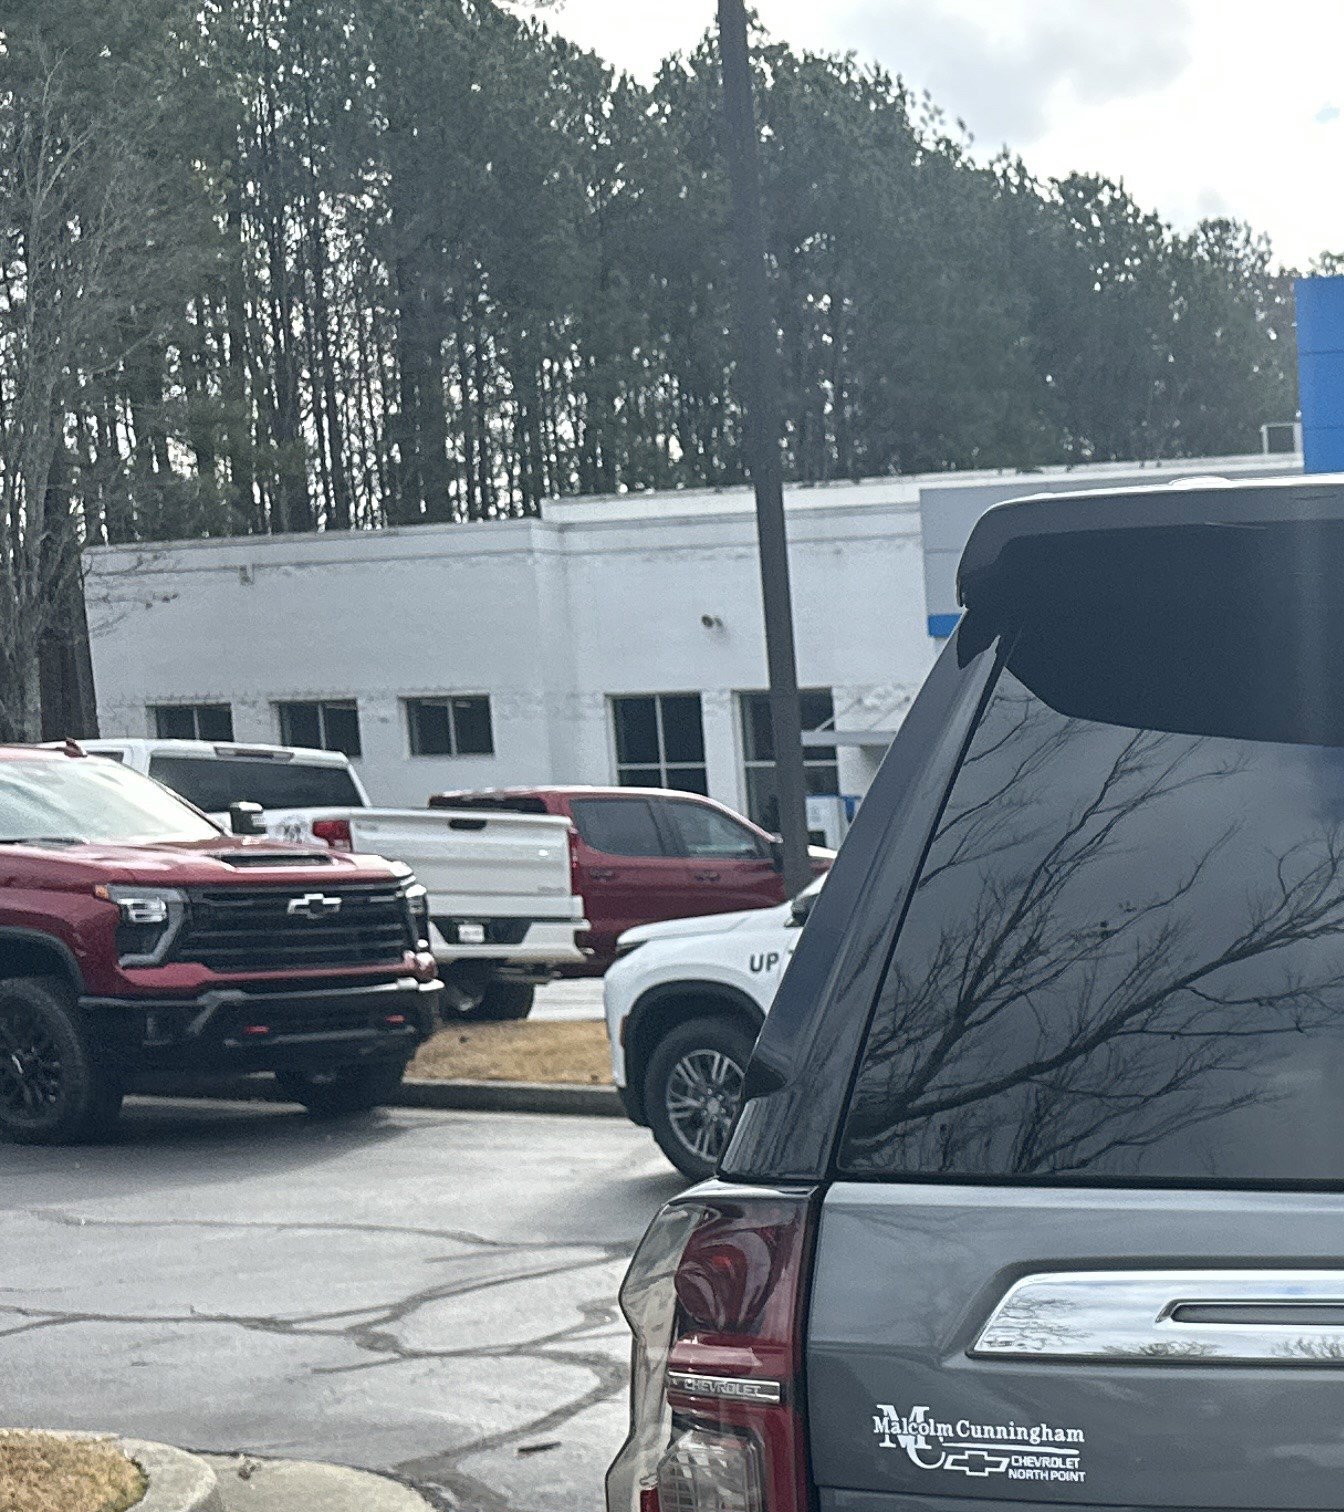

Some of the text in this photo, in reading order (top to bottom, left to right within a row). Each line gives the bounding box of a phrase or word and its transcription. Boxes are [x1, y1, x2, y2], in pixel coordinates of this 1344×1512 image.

[749, 952, 780, 973] UP
[684, 1379, 761, 1397] CHEVROLET
[872, 1416, 1085, 1444] Malcolm Cunningham
[1011, 1455, 1081, 1468] CHEVROLET
[1008, 1469, 1086, 1482] NORTH POINT
